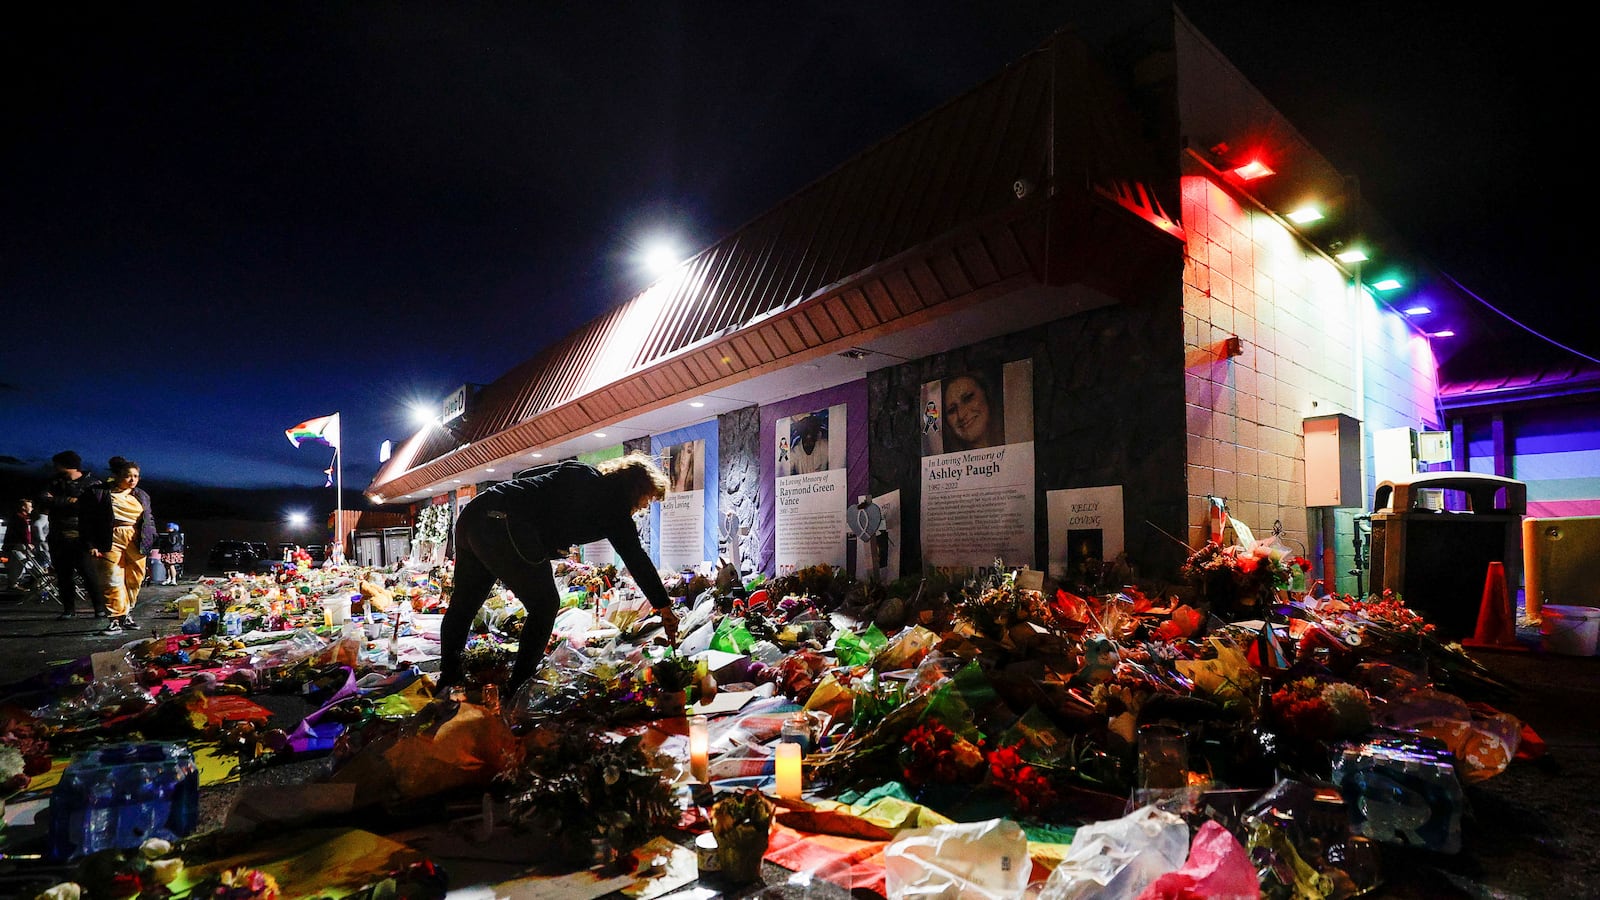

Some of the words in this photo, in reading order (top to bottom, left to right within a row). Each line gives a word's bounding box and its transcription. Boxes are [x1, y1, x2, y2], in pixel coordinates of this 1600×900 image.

[928, 460, 936, 468] In
[937, 457, 961, 466] Loving
[962, 452, 995, 463] Memory
[996, 449, 1006, 461] of
[928, 467, 963, 481] Ashley
[966, 462, 1000, 477] Paugh
[785, 478, 802, 486] Loving
[802, 475, 822, 484] Memory
[823, 474, 829, 482] of
[945, 482, 959, 490] 2022
[779, 485, 811, 498] Raymond
[812, 483, 835, 493] Green
[674, 500, 690, 511] Loving
[779, 497, 800, 506] Vance
[1070, 502, 1099, 513] KELLY
[1069, 515, 1101, 527] LOVING
